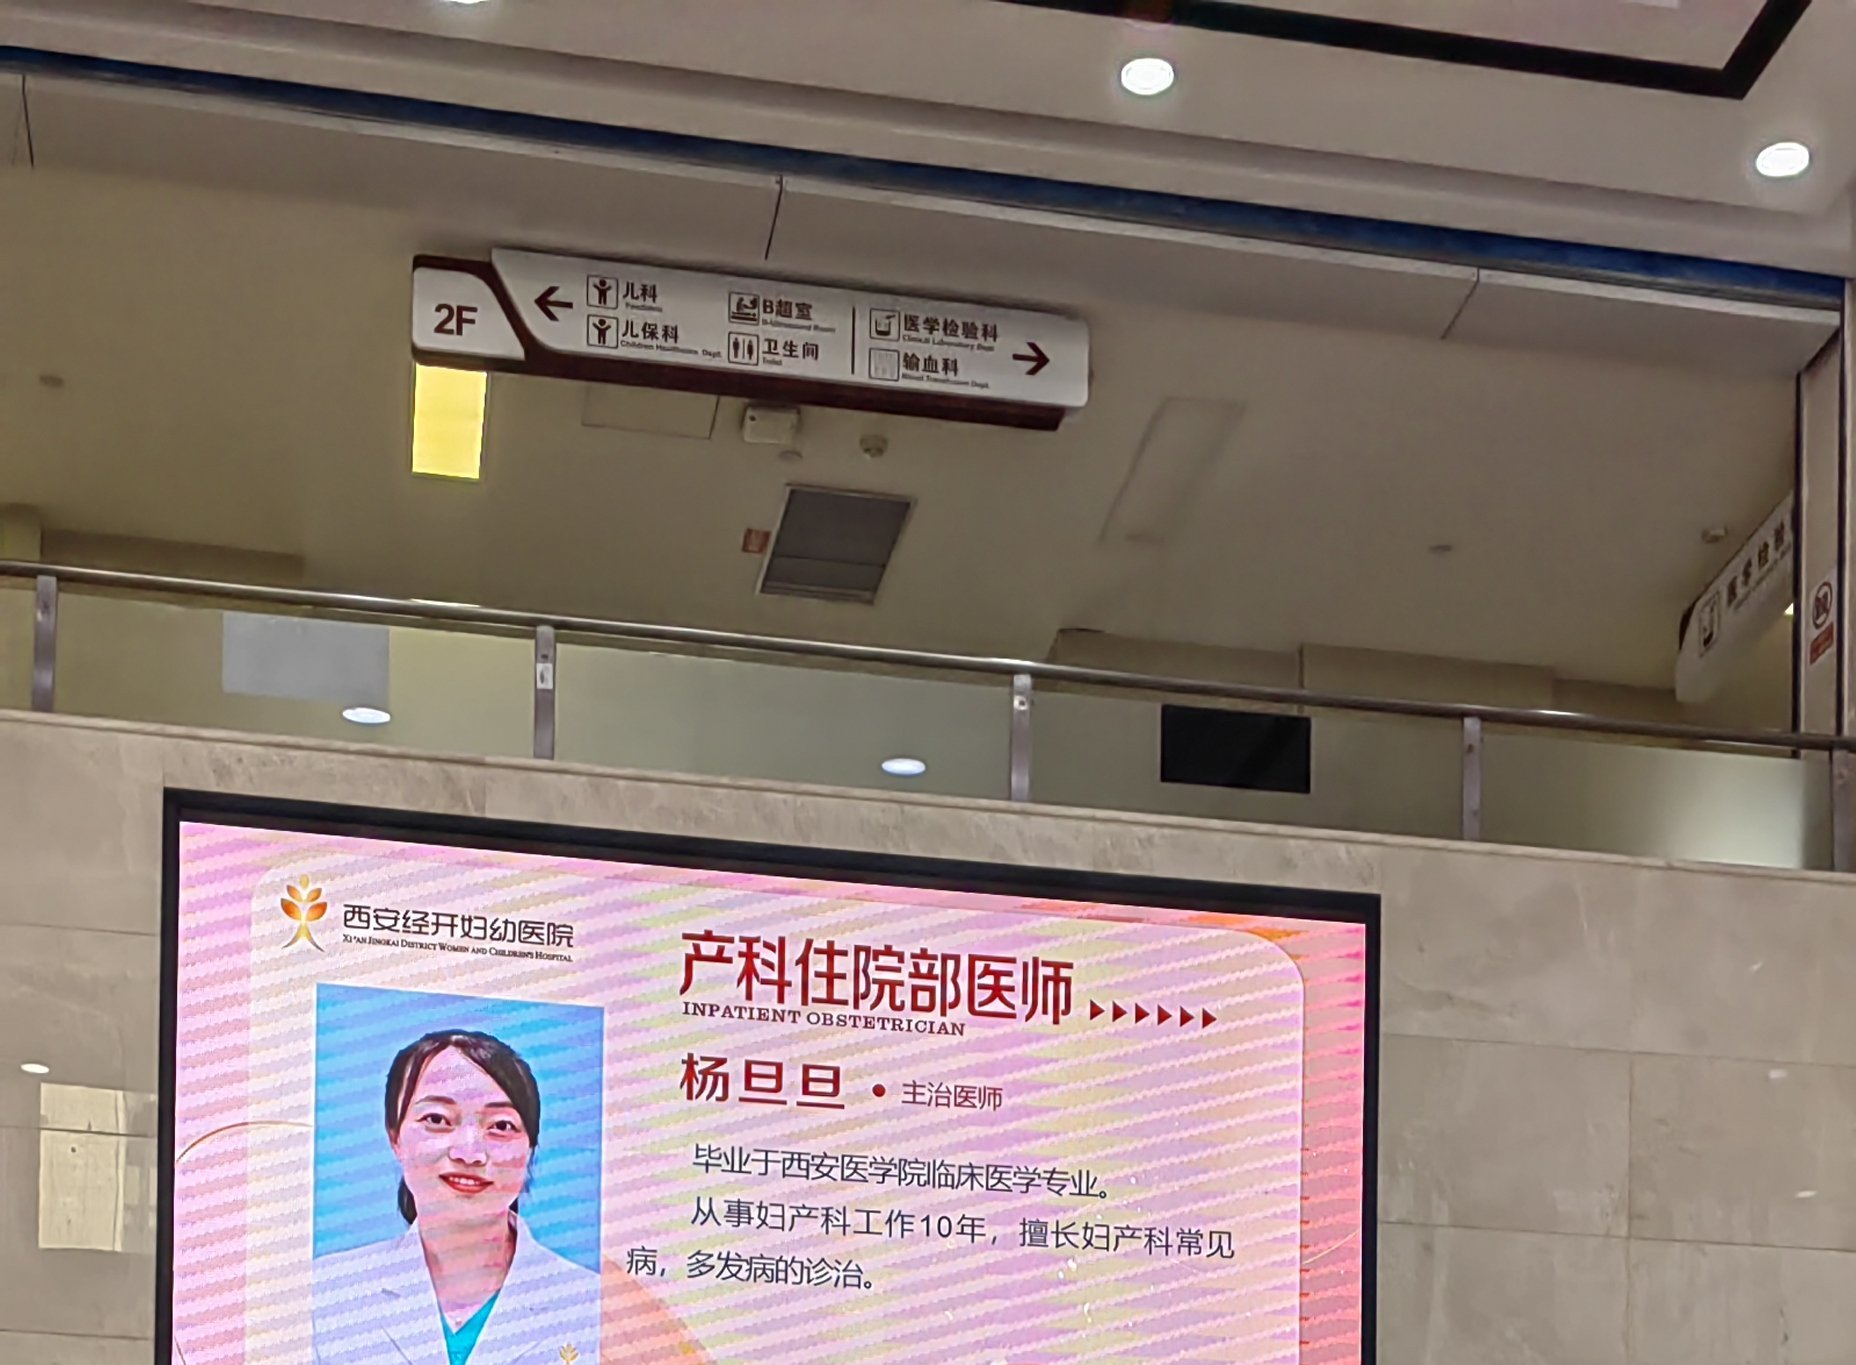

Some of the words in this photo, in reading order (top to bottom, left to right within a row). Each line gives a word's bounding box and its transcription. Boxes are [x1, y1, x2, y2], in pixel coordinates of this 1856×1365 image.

[622, 281, 657, 304] 儿科
[434, 303, 478, 337] 2F
[763, 298, 813, 321] B超室
[622, 319, 679, 344] 儿保科
[904, 312, 998, 343] 医学检验科
[762, 338, 819, 361] 卫生间
[903, 352, 958, 376] 输血科
[343, 904, 574, 948] 西安经开妇幼医院
[368, 936, 400, 947] JINGKAI
[400, 939, 437, 951] DISTRICT
[439, 942, 469, 952] WOMEN
[471, 945, 487, 955] AND
[535, 951, 573, 962] HOSPITAL
[680, 929, 1075, 1025] 产科住院部医师
[682, 1001, 801, 1025] INPATIENT
[806, 1011, 966, 1037] OBSTETRICIAN
[680, 1052, 845, 1109] 杨旦旦
[901, 1081, 1003, 1111] 主治医师
[692, 1142, 1109, 1200] 毕业于西安医学院临床医学专业。
[626, 1246, 874, 1290] 病，多发病的诊治。
